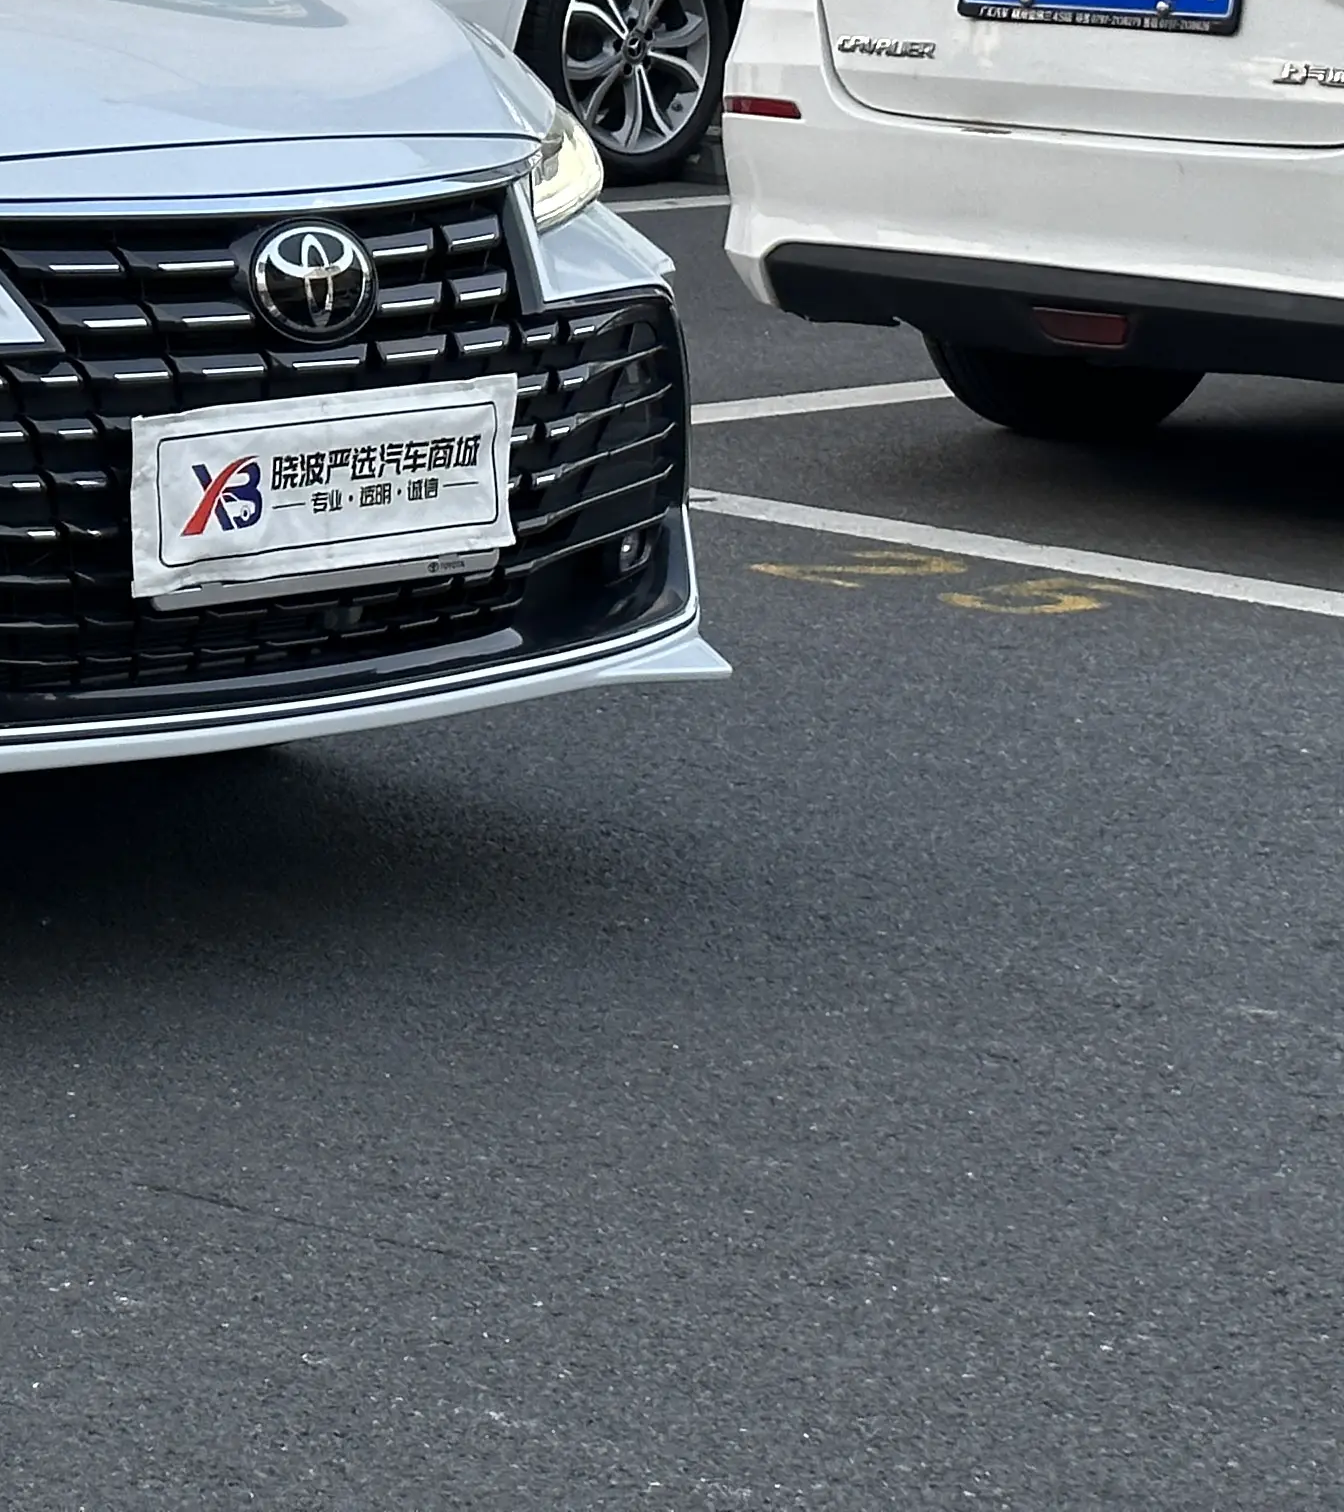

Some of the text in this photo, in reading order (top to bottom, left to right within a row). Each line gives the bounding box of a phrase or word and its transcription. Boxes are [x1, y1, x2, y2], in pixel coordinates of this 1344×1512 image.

[270, 434, 481, 491] 晓波严选汽车商城
